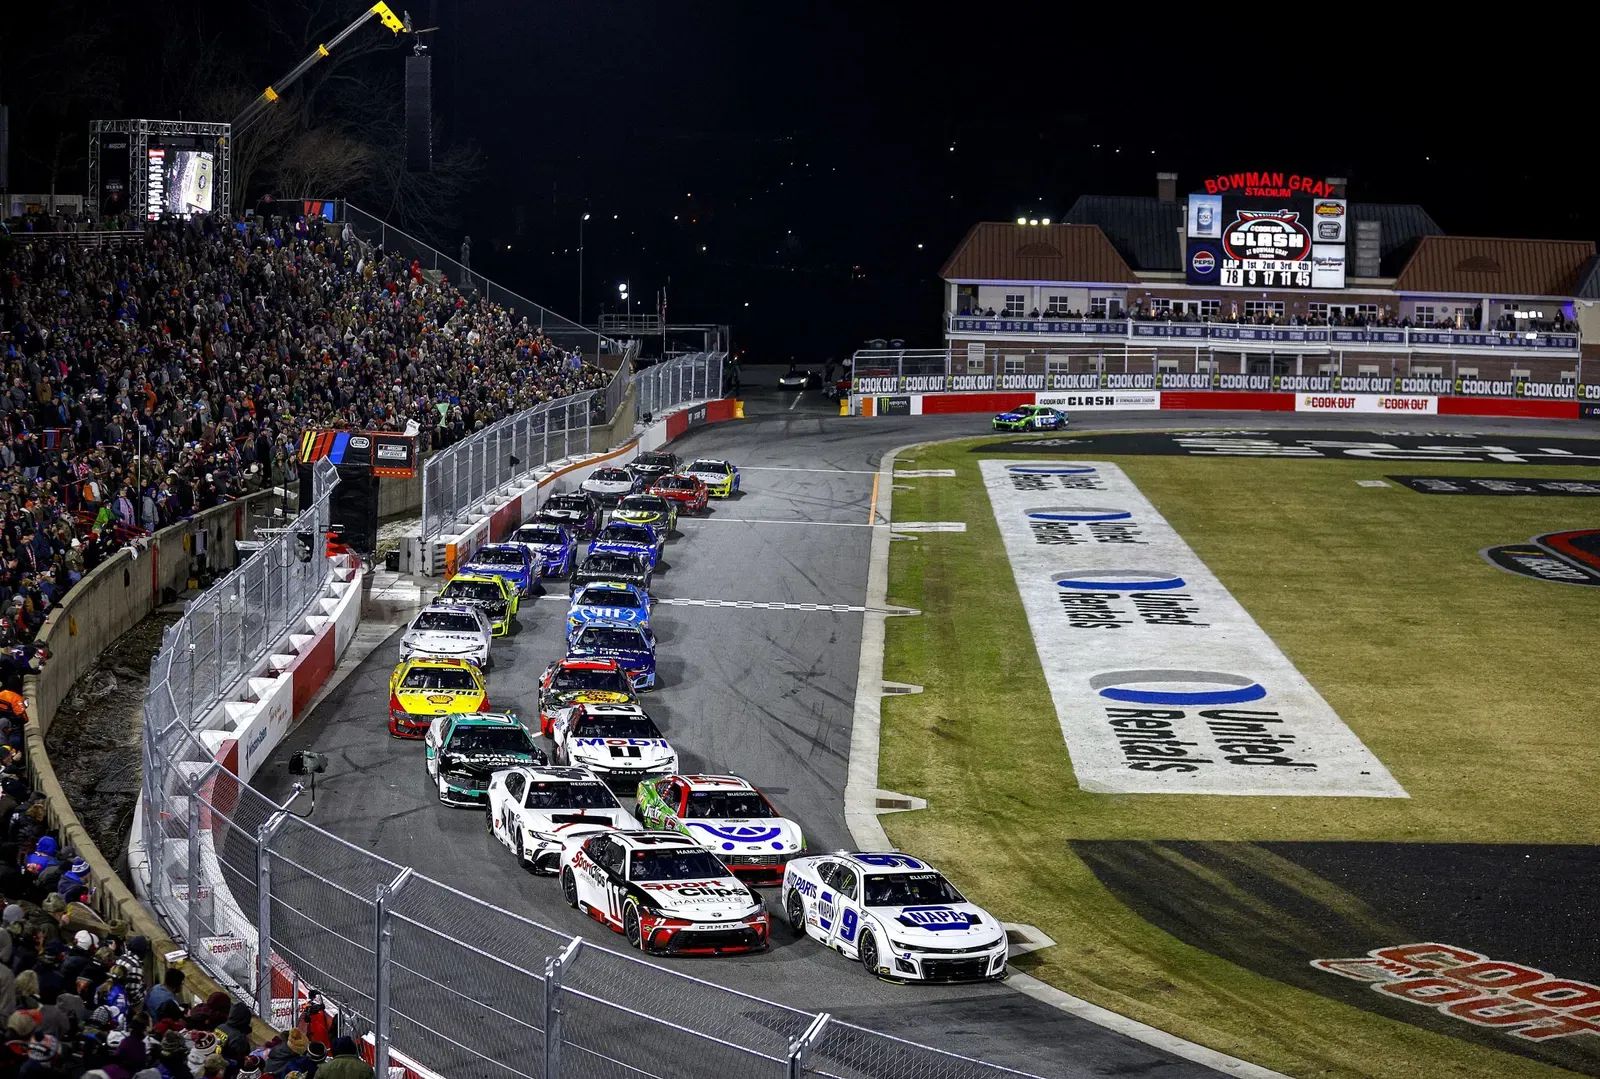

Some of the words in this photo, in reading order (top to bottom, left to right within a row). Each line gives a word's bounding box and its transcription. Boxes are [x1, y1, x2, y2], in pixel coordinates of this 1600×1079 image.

[1204, 171, 1284, 195] BOWMAN
[1288, 176, 1335, 197] GRAY
[1244, 187, 1292, 197] STADIUM
[1230, 232, 1304, 248] CLASH
[1222, 259, 1240, 269] LAP
[1247, 261, 1257, 269] 1st
[1262, 261, 1275, 269] 2nd
[1280, 261, 1292, 270] 3rd
[1297, 262, 1309, 270] 4th
[1226, 270, 1238, 284] 78
[1248, 270, 1257, 285] 9
[1262, 271, 1275, 286] 17
[1280, 271, 1291, 286] 11
[1295, 271, 1310, 286] 45
[860, 377, 882, 393] COOK
[882, 377, 898, 392] OUT
[905, 376, 929, 391] COOK
[929, 376, 944, 390] OUT
[953, 375, 979, 390] COOK
[979, 375, 993, 389] OUT
[1002, 374, 1028, 389] COOK
[1027, 374, 1045, 389] OUT
[1053, 374, 1080, 389] COOK
[1080, 374, 1098, 388] OUT
[1107, 374, 1134, 388] COOK
[1133, 374, 1153, 388] OUT
[1162, 374, 1192, 388] COOK
[1191, 374, 1210, 388] OUT
[1220, 375, 1253, 389] COOK
[1252, 375, 1270, 389] OUT
[1280, 376, 1310, 390] COOK
[1310, 377, 1331, 390] OUT
[1341, 377, 1371, 391] COOK
[1370, 378, 1391, 392] OUT
[1401, 378, 1431, 392] COOK
[1431, 379, 1451, 393] OUT
[1462, 380, 1492, 394] COOK
[1492, 381, 1513, 395] OUT
[1524, 382, 1554, 397] COOK
[1553, 384, 1575, 398] OUT
[1068, 396, 1114, 406] CLASH
[1311, 397, 1337, 408] COOK
[1337, 398, 1356, 408] OUT
[1384, 398, 1411, 409] COOK
[1410, 399, 1429, 410] OUT
[1059, 591, 1133, 629] Rentals
[1128, 592, 1210, 628] United
[398, 689, 480, 697] PENNZOIL
[574, 738, 669, 748] Mobil
[1104, 706, 1214, 774] Rentals
[1198, 708, 1318, 773] United
[451, 757, 542, 766] SUBMARINES
[640, 880, 726, 891] Sport
[678, 887, 750, 898] Clips
[795, 875, 818, 900] PARTS
[673, 896, 743, 906] HAIRCUTS
[818, 899, 834, 921] NAPA
[908, 910, 961, 924] NAPA
[654, 917, 666, 926] 11
[698, 922, 738, 930] CAMRY
[840, 906, 859, 943] 9
[902, 952, 912, 960] 9
[1366, 942, 1600, 1025] COO
